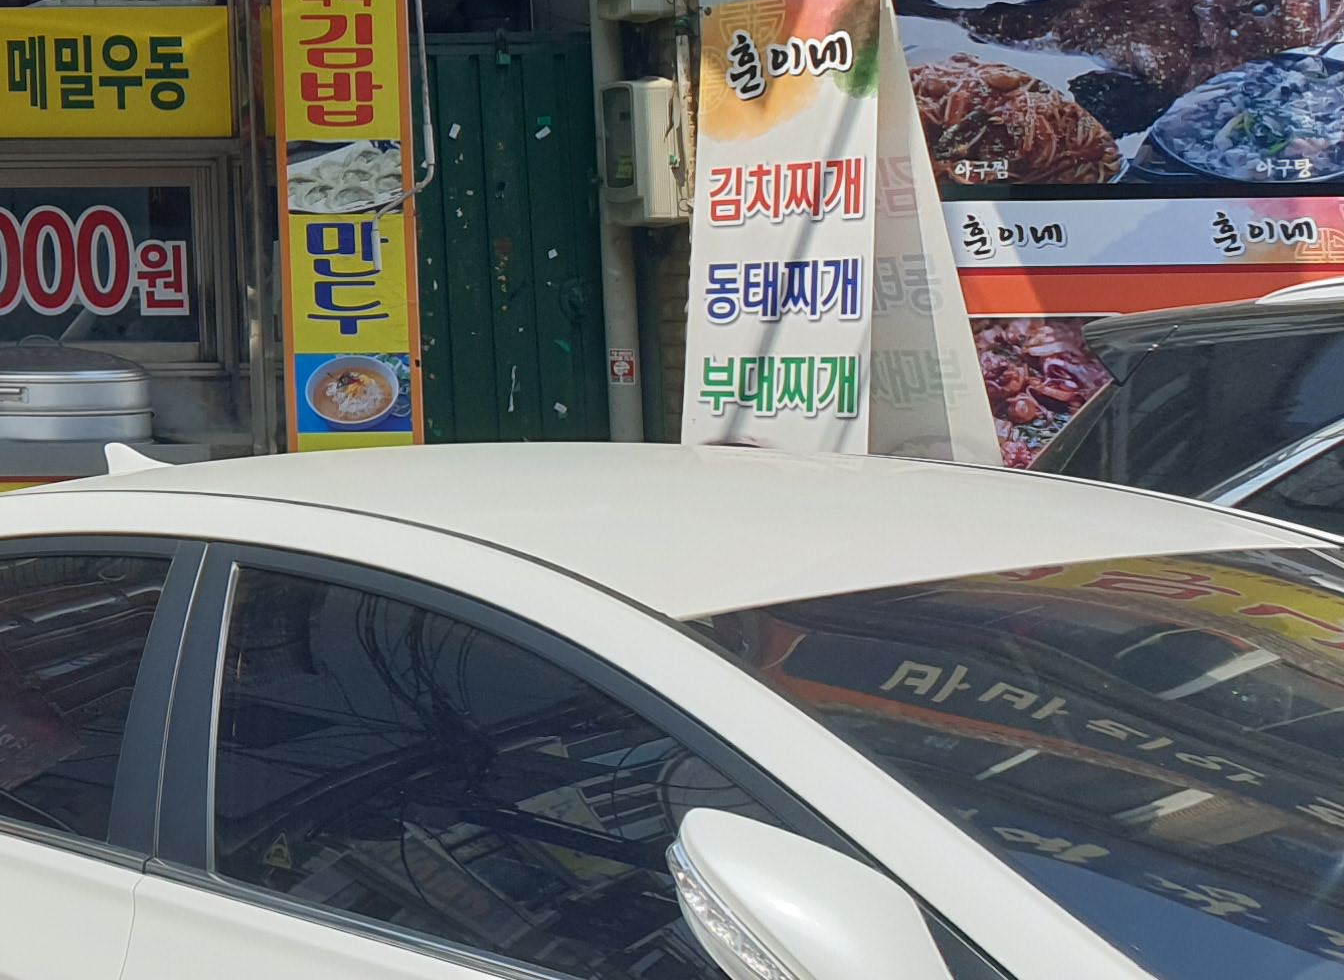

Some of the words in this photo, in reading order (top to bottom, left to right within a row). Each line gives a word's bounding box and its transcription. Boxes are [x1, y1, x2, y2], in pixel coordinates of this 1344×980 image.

[7, 35, 190, 112] 메밀우동
[300, 13, 383, 127] 김밥
[728, 33, 852, 97] 훈이네
[710, 157, 863, 223] 김치찌개
[955, 159, 1009, 182] 아구찜
[1256, 158, 1313, 180] 아구탕
[964, 217, 1066, 256] 훈이네
[1212, 212, 1316, 255] 훈이네
[306, 221, 389, 335] 만두
[706, 258, 860, 322] 동태찌개
[699, 355, 859, 415] 부대찌개
